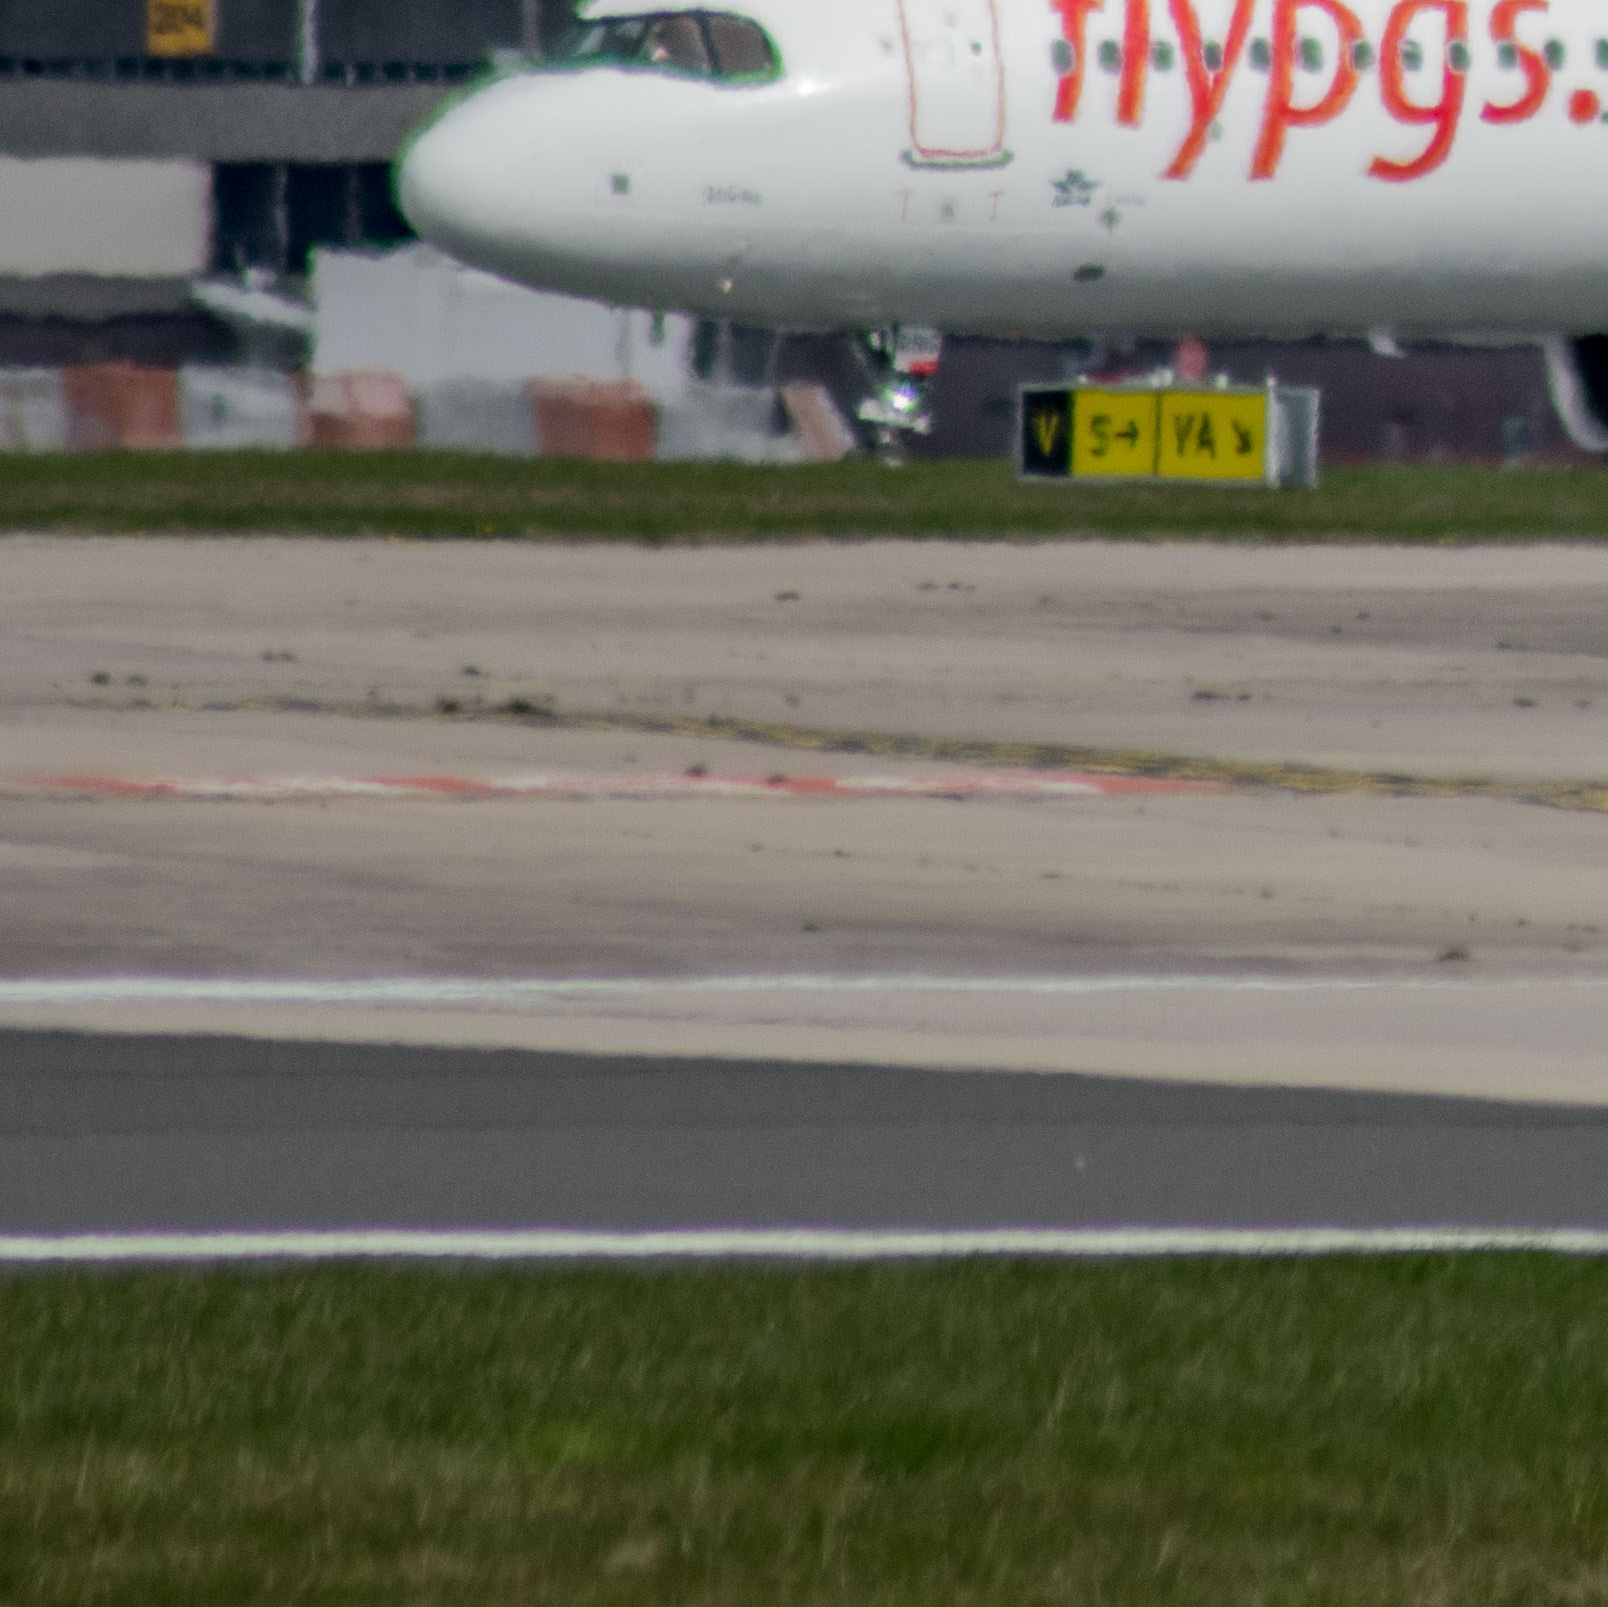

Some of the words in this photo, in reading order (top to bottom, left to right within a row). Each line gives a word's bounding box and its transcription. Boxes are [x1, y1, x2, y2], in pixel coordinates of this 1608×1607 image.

[1033, 411, 1060, 458] V
[1089, 413, 1111, 458] S
[1174, 411, 1217, 460] VA
